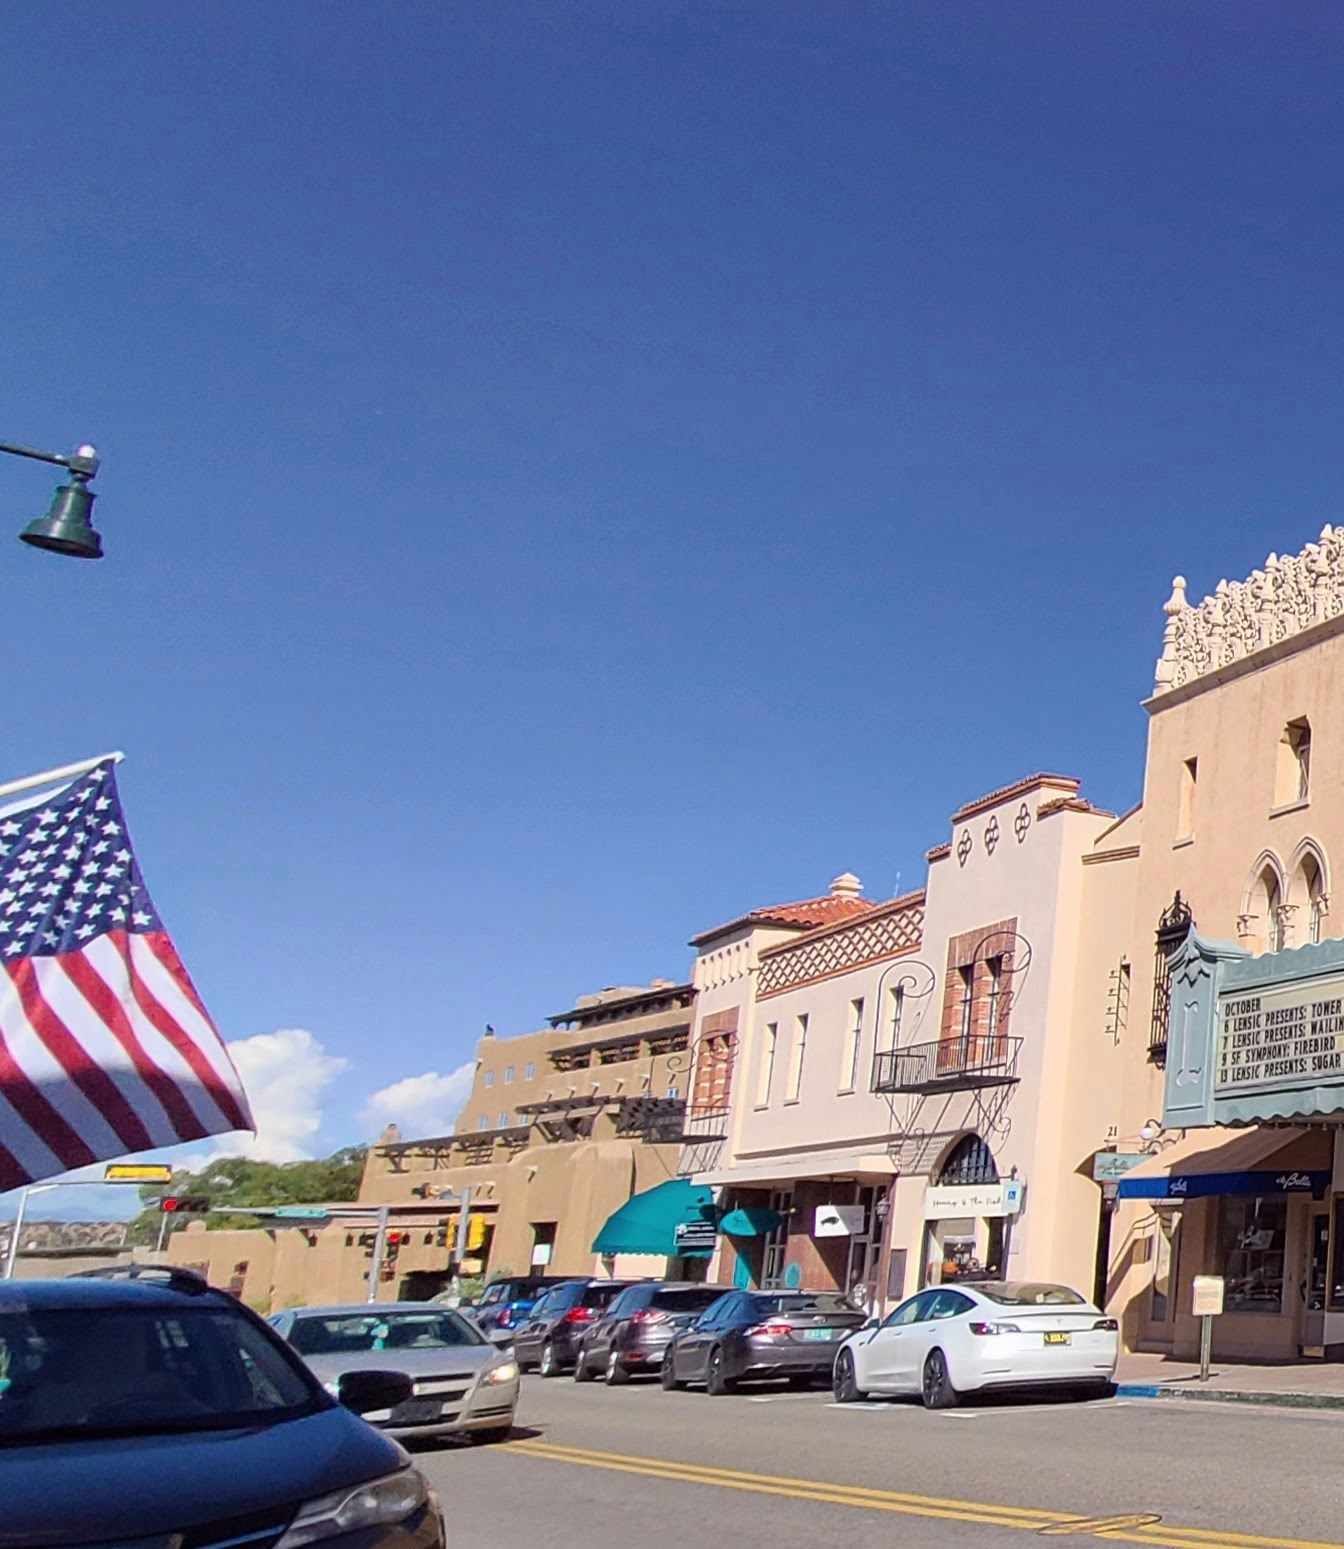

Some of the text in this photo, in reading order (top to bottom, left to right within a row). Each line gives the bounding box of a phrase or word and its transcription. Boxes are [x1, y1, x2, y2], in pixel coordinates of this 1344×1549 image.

[1224, 1021, 1229, 1033] 6
[1233, 1014, 1261, 1033] LENSIC
[1265, 1006, 1308, 1027] PRESENTS:
[1312, 999, 1342, 1018] TOWER
[1225, 998, 1261, 1017] OCTOBER
[1223, 1037, 1228, 1049] 7
[1232, 1030, 1261, 1049] LENSIC
[1264, 1023, 1306, 1043] PRESENTS:
[1222, 1036, 1336, 1067] 9 SF SYMPHONY: FIREBIRD
[1220, 1069, 1228, 1083] 13
[1232, 1063, 1261, 1082] LENSIC
[1264, 1056, 1308, 1078] PRESENTS:
[1312, 1054, 1342, 1071] SUGAR
[1107, 1125, 1118, 1136] 21
